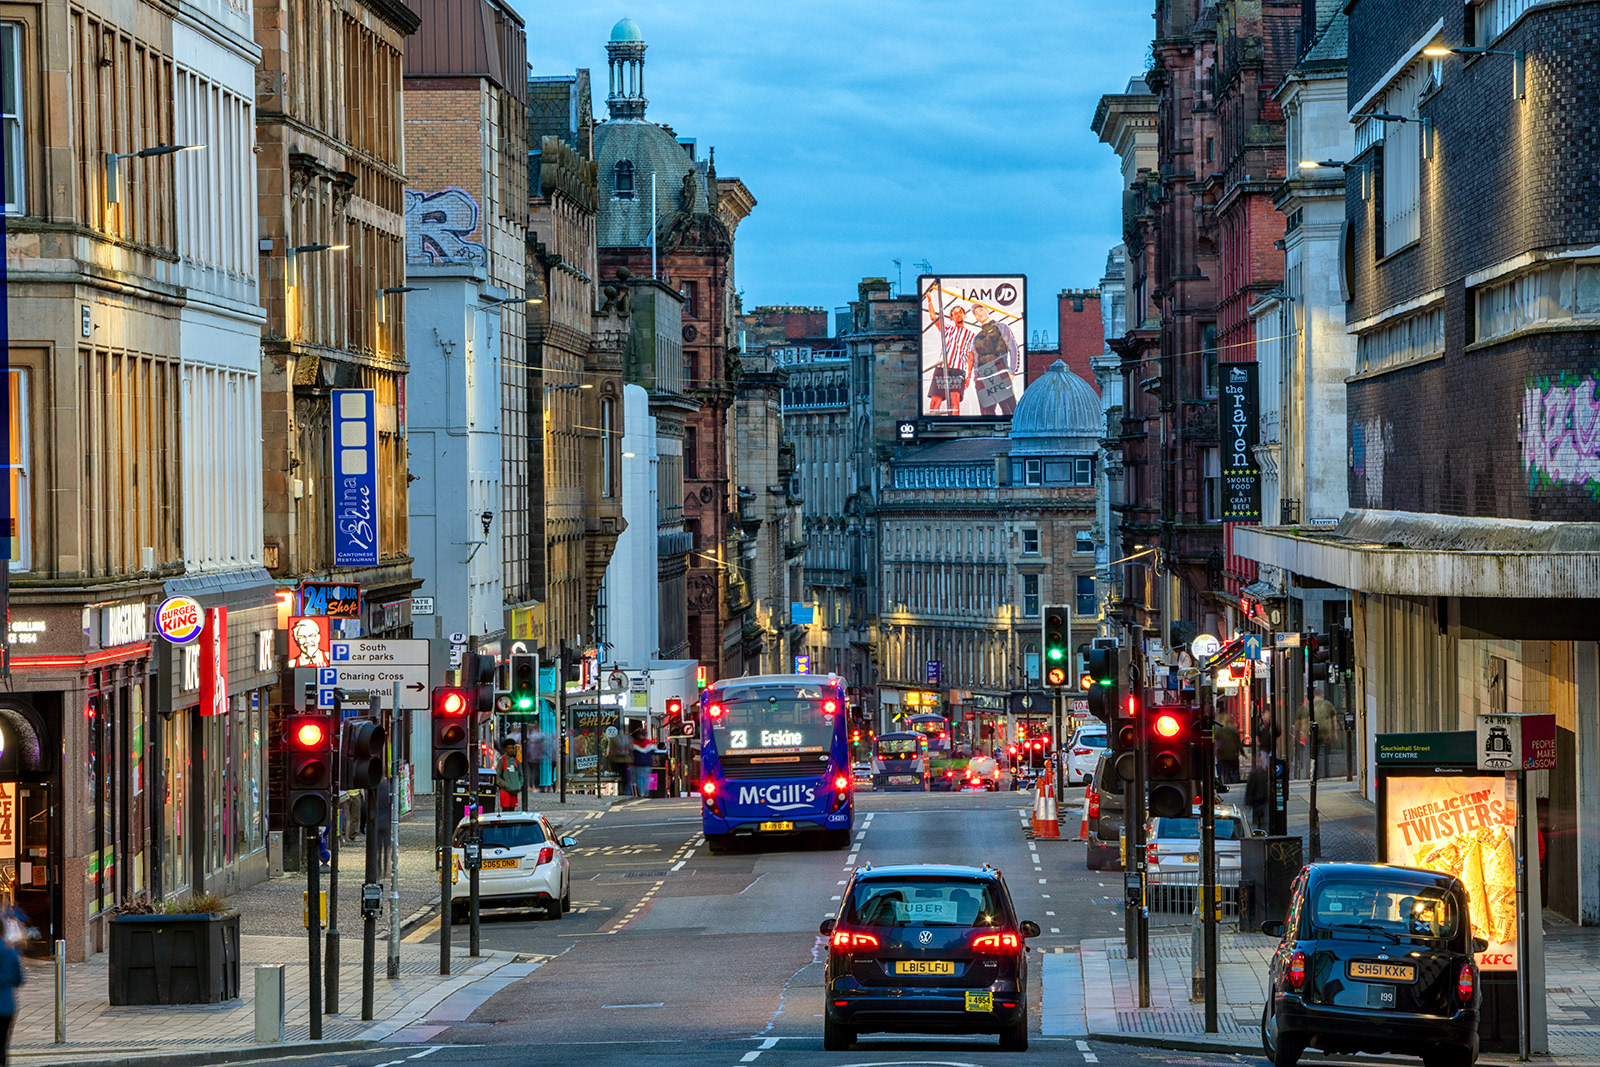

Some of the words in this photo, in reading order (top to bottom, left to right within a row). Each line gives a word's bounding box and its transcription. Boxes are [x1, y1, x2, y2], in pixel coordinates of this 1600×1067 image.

[969, 288, 992, 300] AM
[986, 382, 1005, 396] KFC
[1225, 385, 1243, 393] the
[1232, 394, 1249, 466] raven
[304, 586, 326, 615] 24
[327, 587, 358, 600] HOUR
[161, 605, 196, 622] BURGER
[327, 602, 358, 615] Shop
[12, 621, 46, 632] GRILLING
[163, 613, 197, 634] KING
[369, 652, 394, 661] parks
[340, 673, 375, 681] Charing
[731, 730, 747, 748] 23
[761, 730, 801, 746] Erskine
[1532, 739, 1556, 749] PEOPLE
[1537, 749, 1556, 758] MAKE
[739, 785, 815, 805] McGill's
[1397, 800, 1506, 846] TWISTERS
[905, 904, 943, 913] UBER
[1480, 954, 1513, 965] KFC
[902, 963, 926, 972] LB15
[928, 963, 949, 972] LFU
[1358, 964, 1382, 975] SH51
[1385, 966, 1406, 977] KXK
[1380, 993, 1393, 1001] 199
